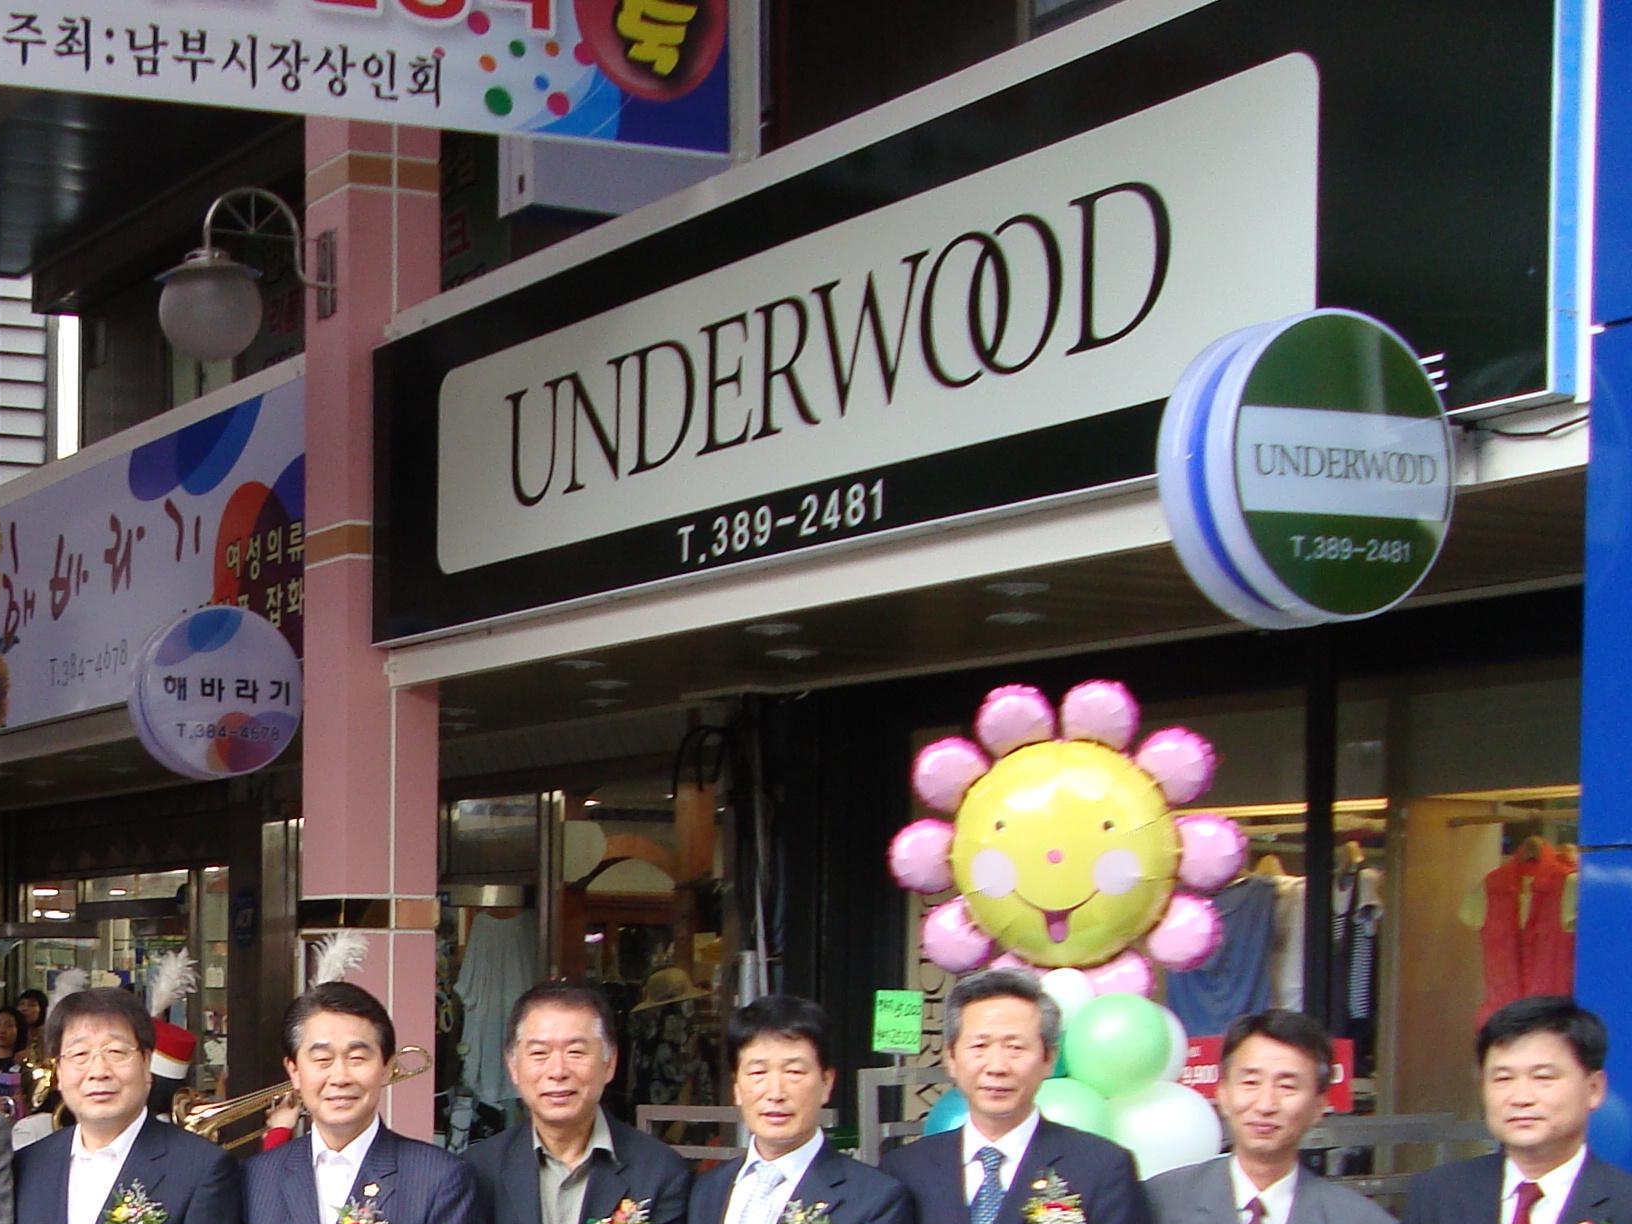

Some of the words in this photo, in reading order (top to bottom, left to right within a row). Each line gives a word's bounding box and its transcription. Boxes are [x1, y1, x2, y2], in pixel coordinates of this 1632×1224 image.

[2, 12, 445, 107] 주최:남부시장상인회
[504, 181, 1171, 507] UNDERWOOD
[1253, 443, 1438, 486] UNDERWOOD
[676, 477, 886, 566] T.389-2481
[224, 520, 305, 581] 여성의류
[1289, 534, 1413, 563] T.389-2481
[163, 674, 291, 706] 해바라기
[176, 722, 281, 742] T.384-4678
